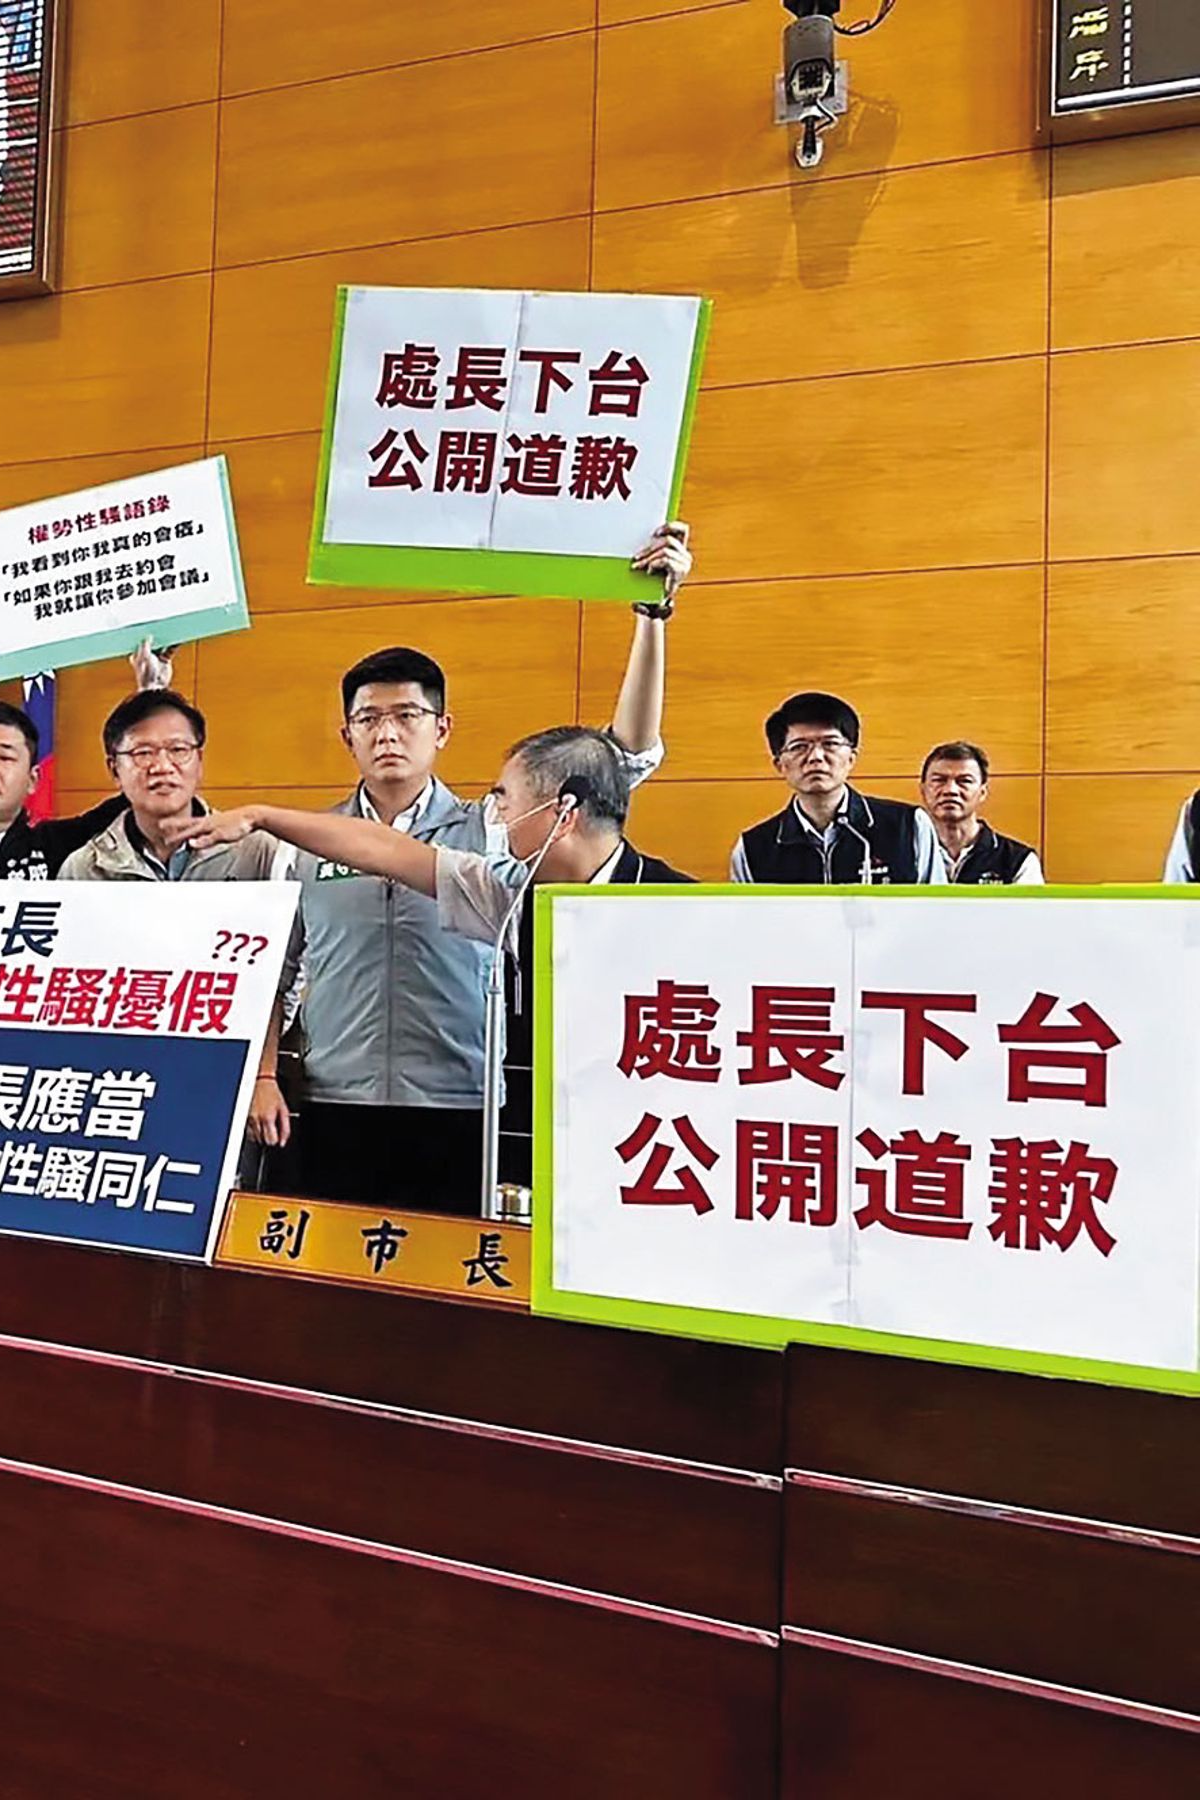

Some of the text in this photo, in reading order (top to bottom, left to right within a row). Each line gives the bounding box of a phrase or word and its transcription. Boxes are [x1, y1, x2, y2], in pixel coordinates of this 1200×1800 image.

[376, 343, 650, 418] 處長下台
[368, 428, 639, 501] 公開道歉
[28, 495, 171, 545] 權勢性騷語錄
[617, 979, 1122, 1108] 處長下台
[615, 1111, 1119, 1258] 公開道歉
[259, 1210, 513, 1288] 副市長
